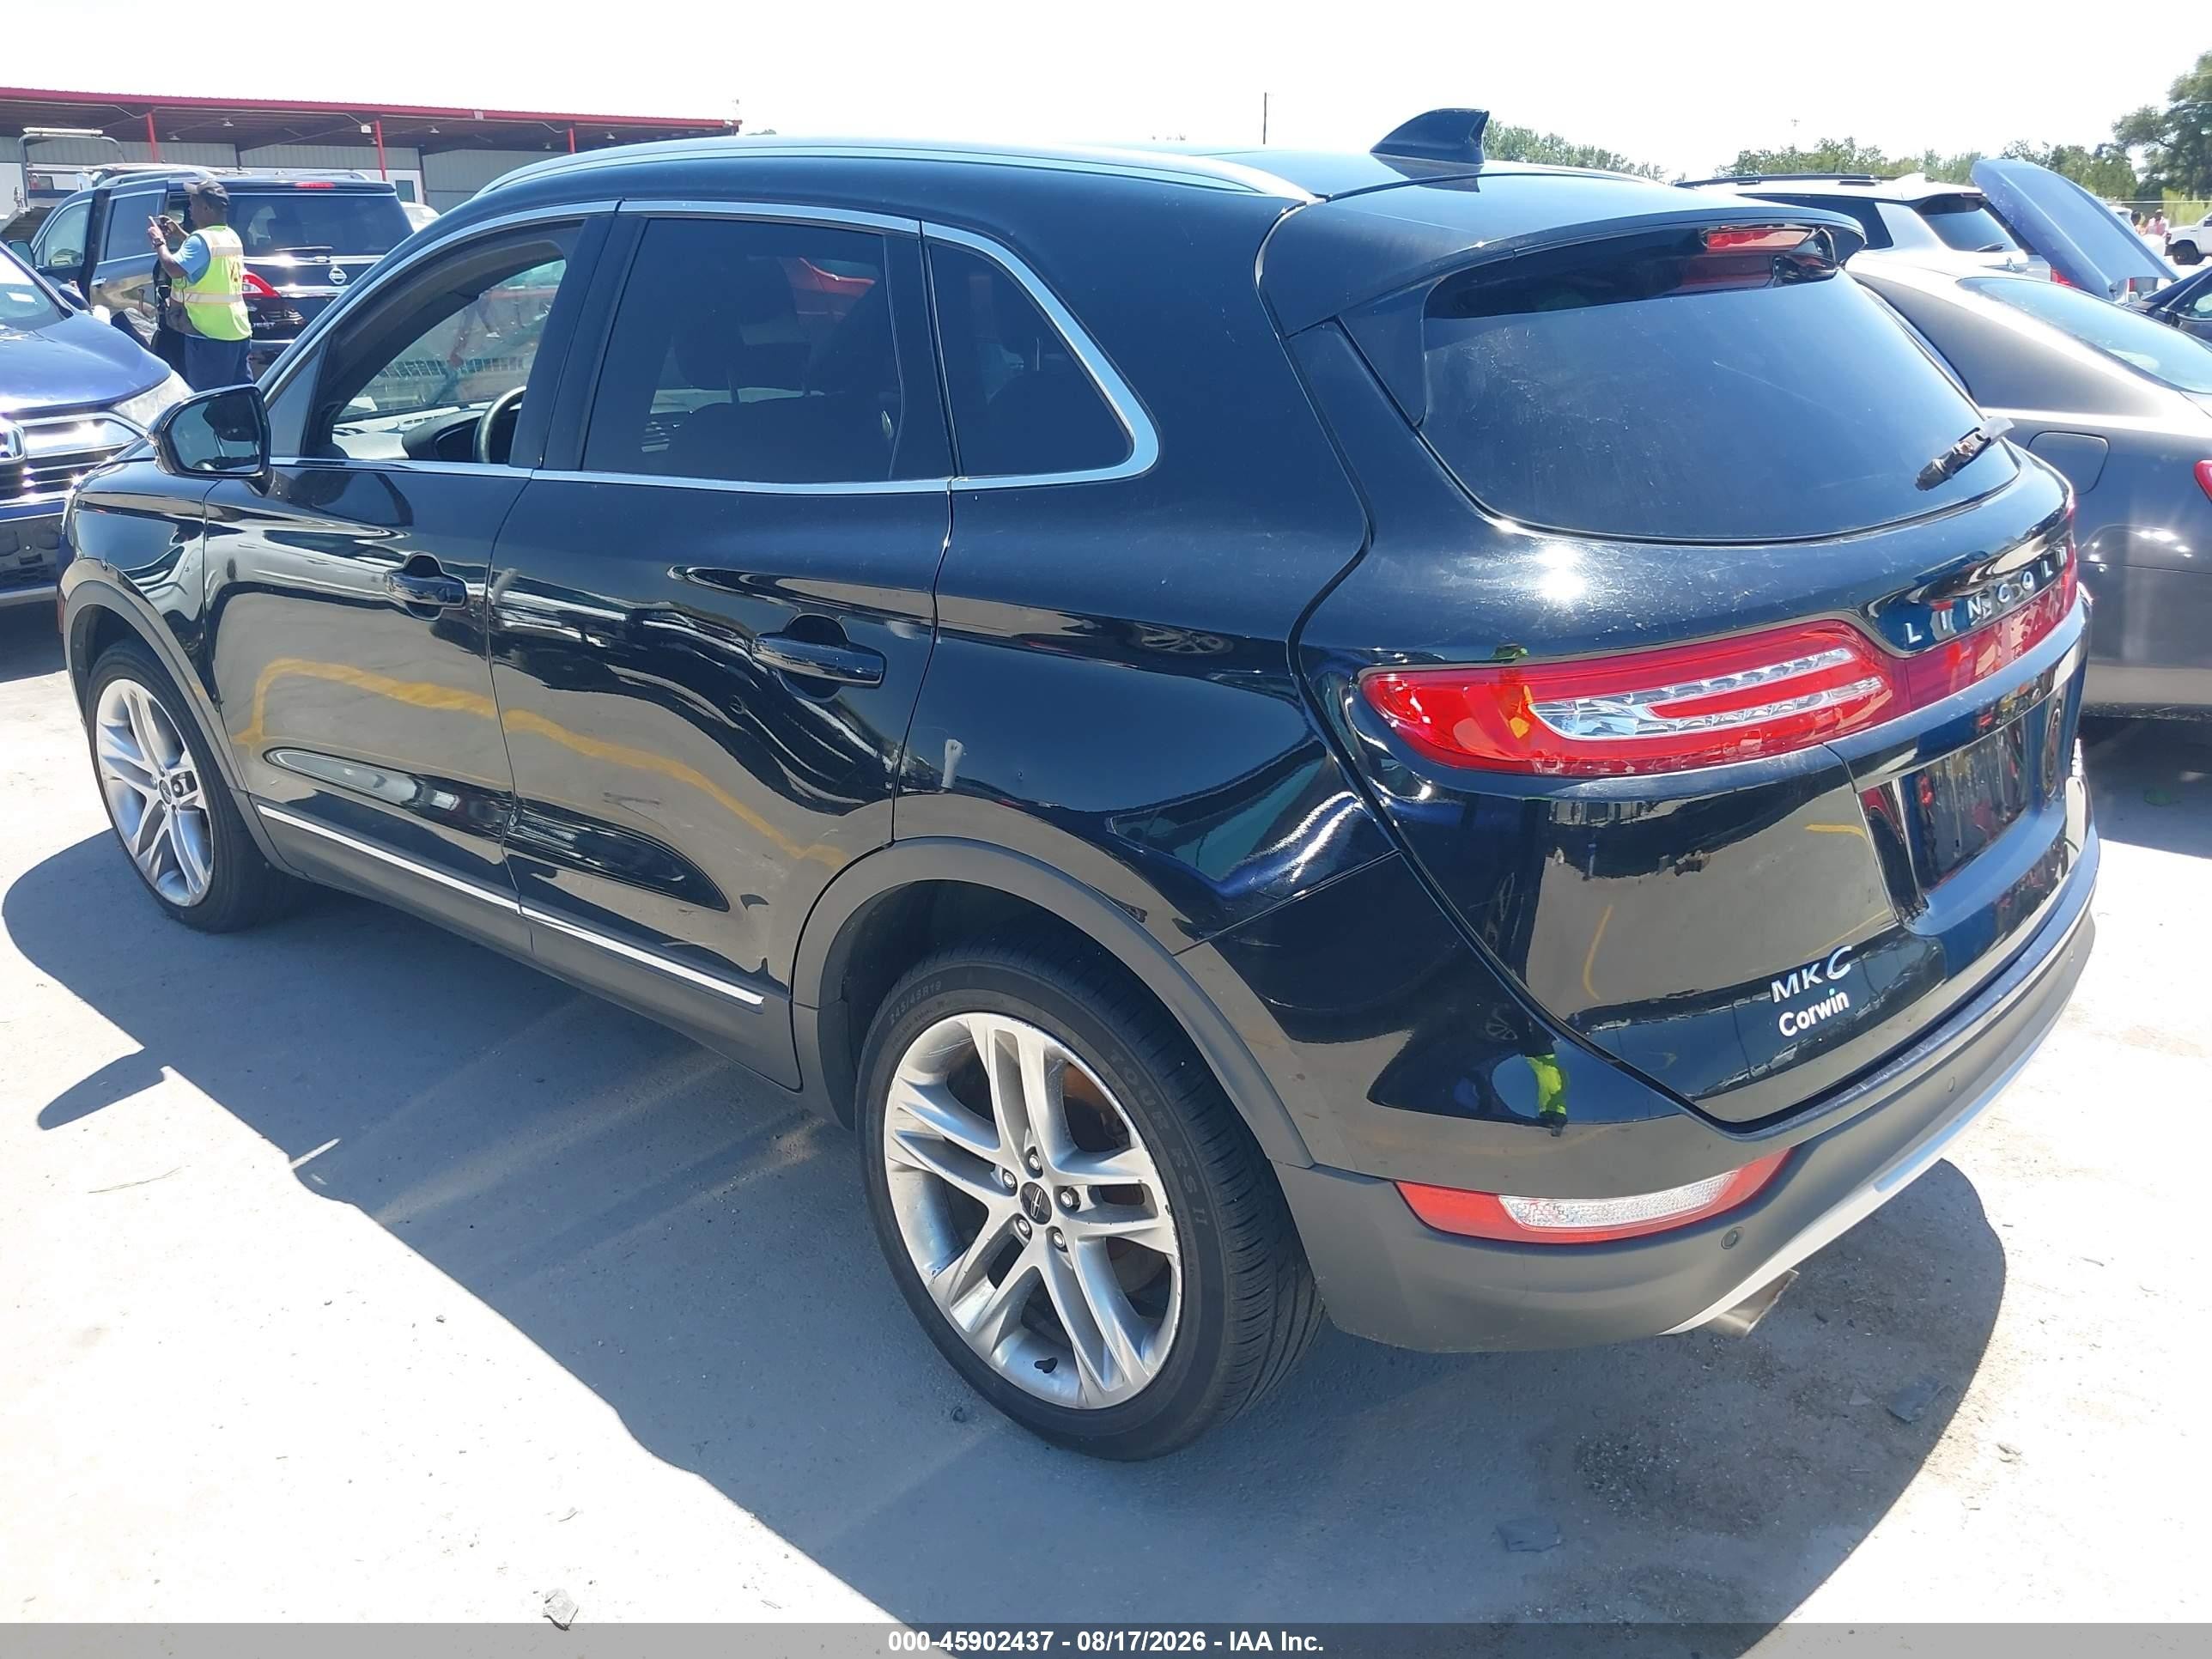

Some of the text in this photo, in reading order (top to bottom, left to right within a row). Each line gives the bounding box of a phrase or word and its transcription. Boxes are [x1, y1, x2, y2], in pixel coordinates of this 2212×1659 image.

[1903, 546, 2068, 644] LINCOLN
[1771, 945, 1852, 1003] MKC
[1778, 988, 1850, 1037] Corwin
[1108, 1048, 1172, 1132] TOUR
[1170, 1146, 1198, 1195] RS
